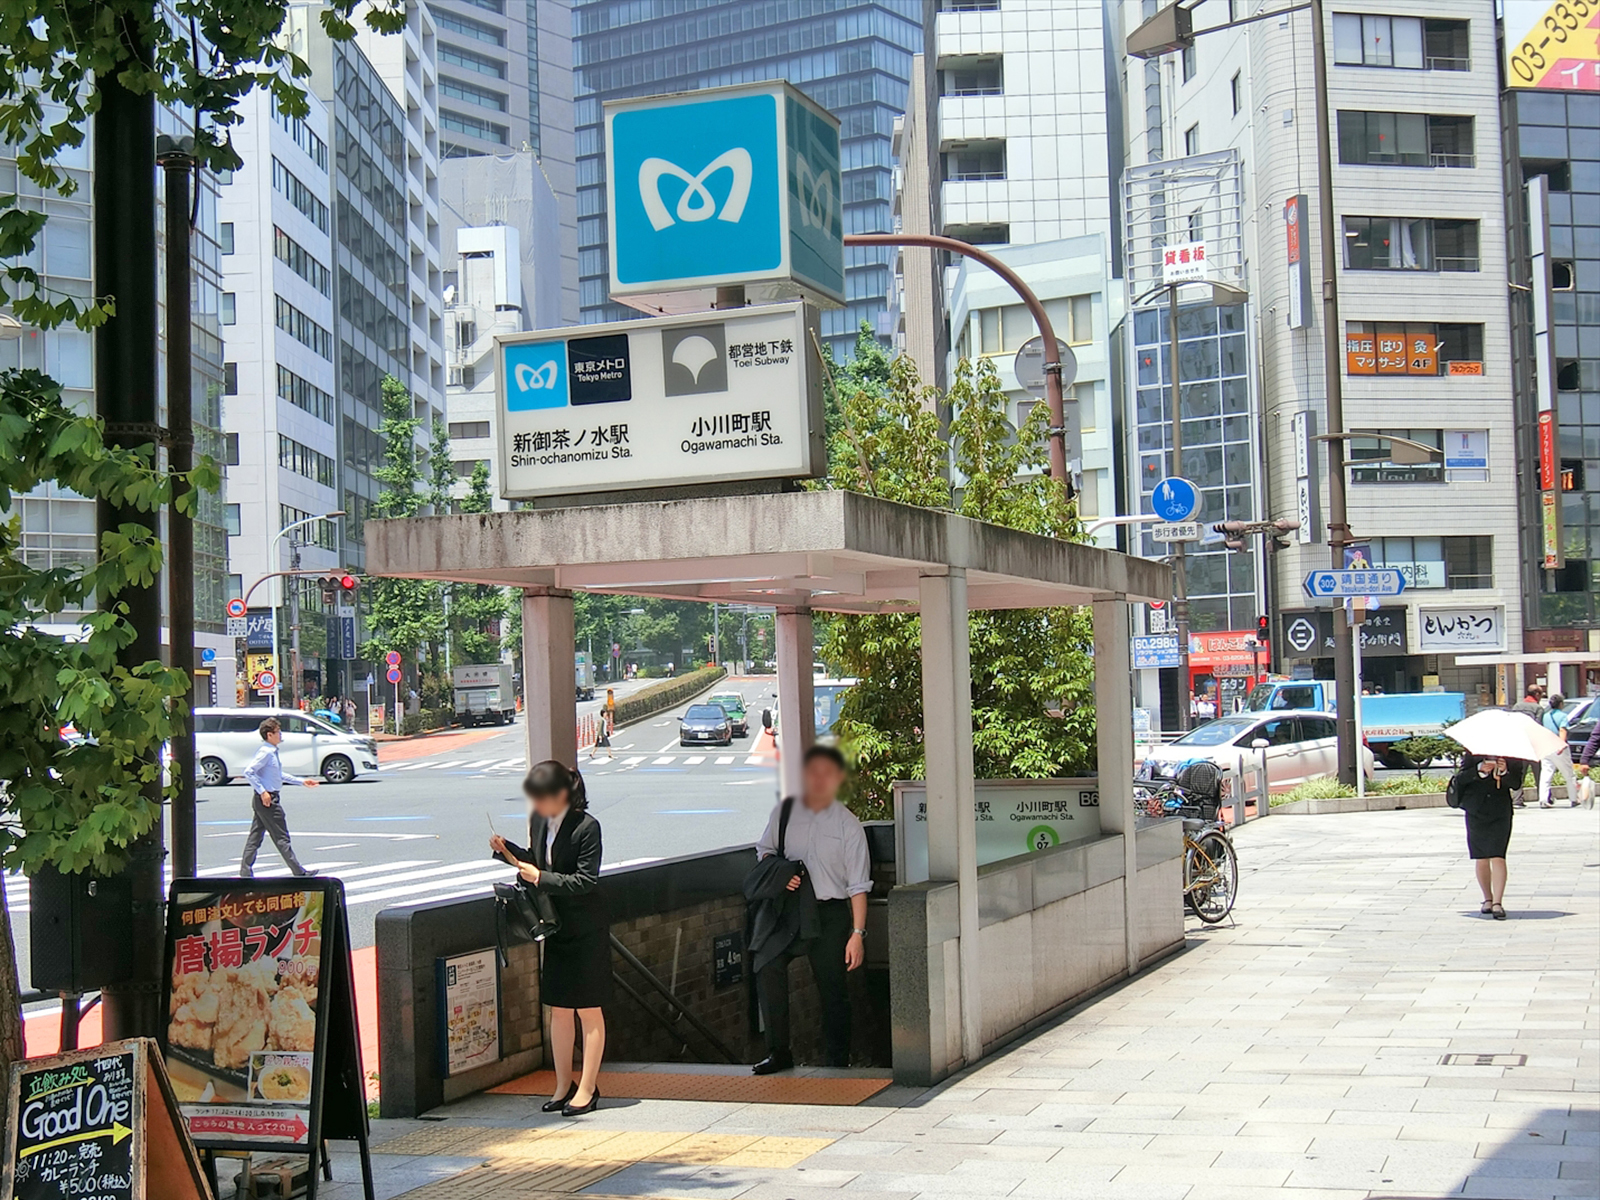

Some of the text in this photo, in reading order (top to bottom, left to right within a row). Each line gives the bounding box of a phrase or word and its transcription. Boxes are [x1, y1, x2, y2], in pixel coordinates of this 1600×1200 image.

[1164, 246, 1204, 266] 貸看板
[728, 338, 793, 359] 都営地下鉄
[1347, 340, 1428, 354] 指圧 はり 灸
[574, 358, 625, 374] 東京メトロ
[733, 354, 790, 368] Toei Subway
[1355, 357, 1432, 368] マッサージ 4F
[577, 370, 622, 382] Tokyo Metro
[691, 410, 771, 437] 小川町駅
[513, 424, 629, 453] 新御茶ノ水駅
[680, 432, 783, 454] Ogawamachi Sta.
[511, 446, 633, 467] Shin-ochanomizu Sta.
[1154, 526, 1196, 538] 歩行者優先
[1320, 573, 1392, 588] 302 靖国通り
[1341, 584, 1380, 593] Yasukuni-dori
[1425, 615, 1493, 636] とんかつ
[262, 676, 272, 684] 40
[1221, 678, 1246, 690] チタン
[1016, 801, 1068, 813] 小川町駅
[1082, 793, 1099, 805] B6
[1010, 813, 1058, 822] Ogawamachi
[174, 918, 318, 975] 唐揚ランチ
[94, 1056, 123, 1073] 十四代
[28, 1066, 88, 1097] 立飲み処
[21, 1084, 83, 1141] Good
[86, 1084, 130, 1126] One
[41, 1162, 99, 1182] カレーランチ
